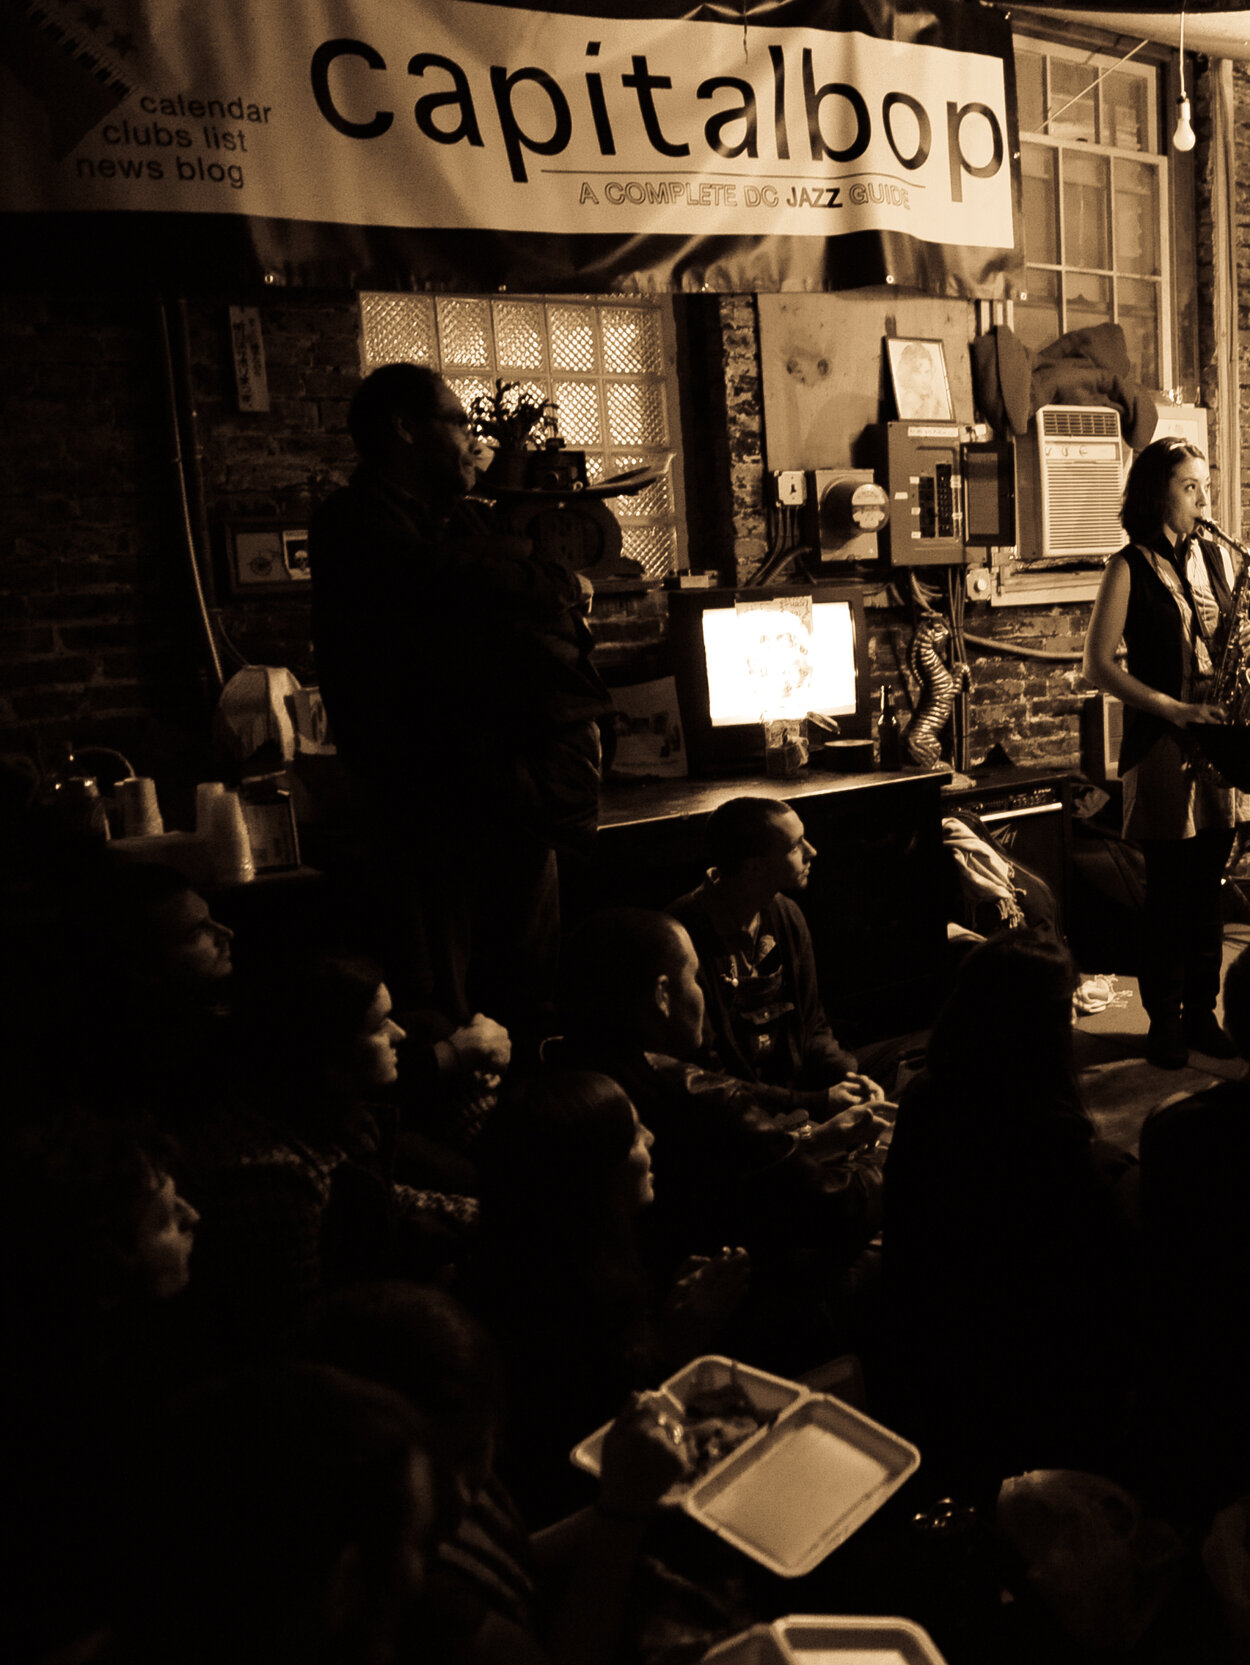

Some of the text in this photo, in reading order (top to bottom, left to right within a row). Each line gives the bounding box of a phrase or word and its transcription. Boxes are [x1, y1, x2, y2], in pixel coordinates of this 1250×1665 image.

[140, 94, 271, 123] calendar
[310, 38, 1004, 203] capitalbop
[102, 120, 247, 152] clubs list
[76, 156, 244, 189] news blog
[579, 181, 912, 210] A COMPLETE DC JAZZ GUIDE
